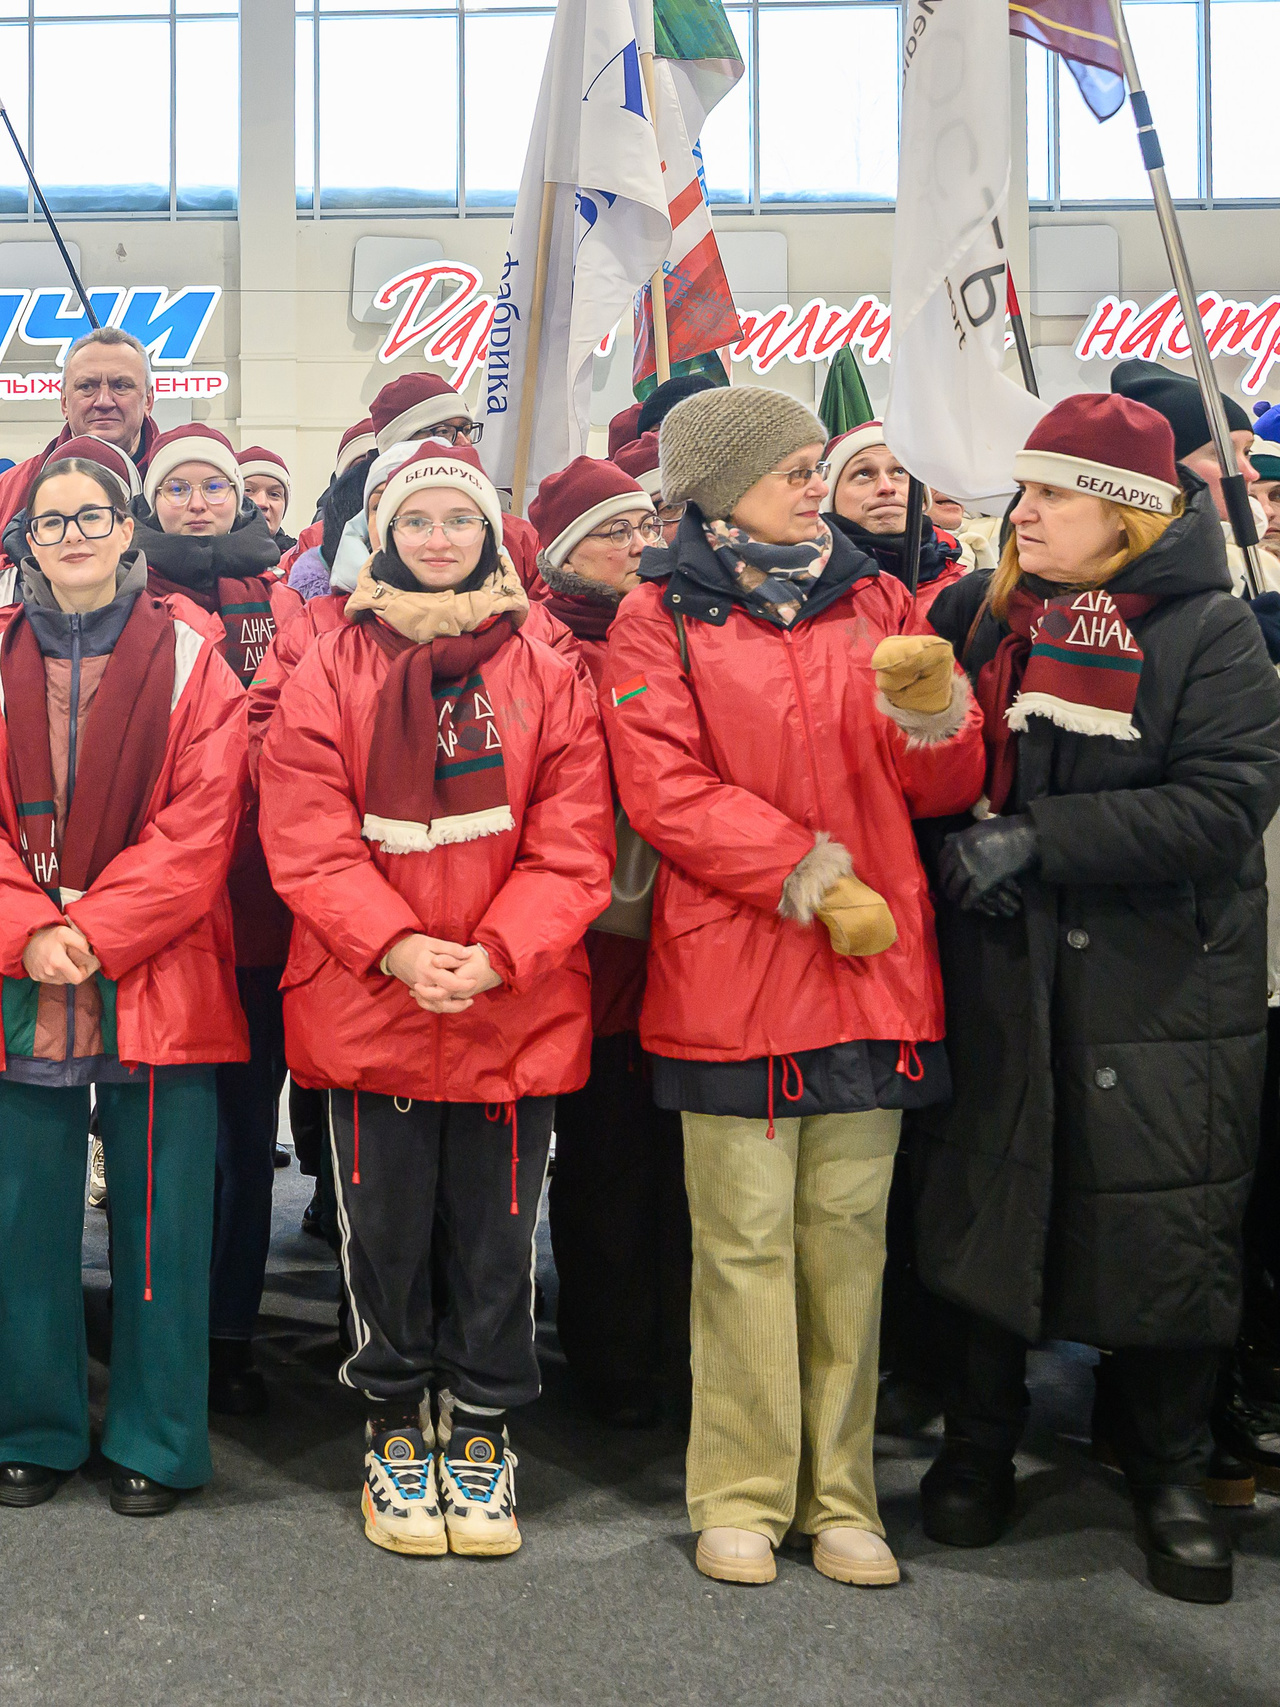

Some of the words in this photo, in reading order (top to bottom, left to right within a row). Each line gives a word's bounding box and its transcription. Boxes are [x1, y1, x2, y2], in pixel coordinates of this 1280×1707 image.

[155, 376, 223, 393] ЕНТР
[405, 465, 483, 491] БЕЛАРУСЬ
[1076, 474, 1163, 511] БЕЛАРУСЬ
